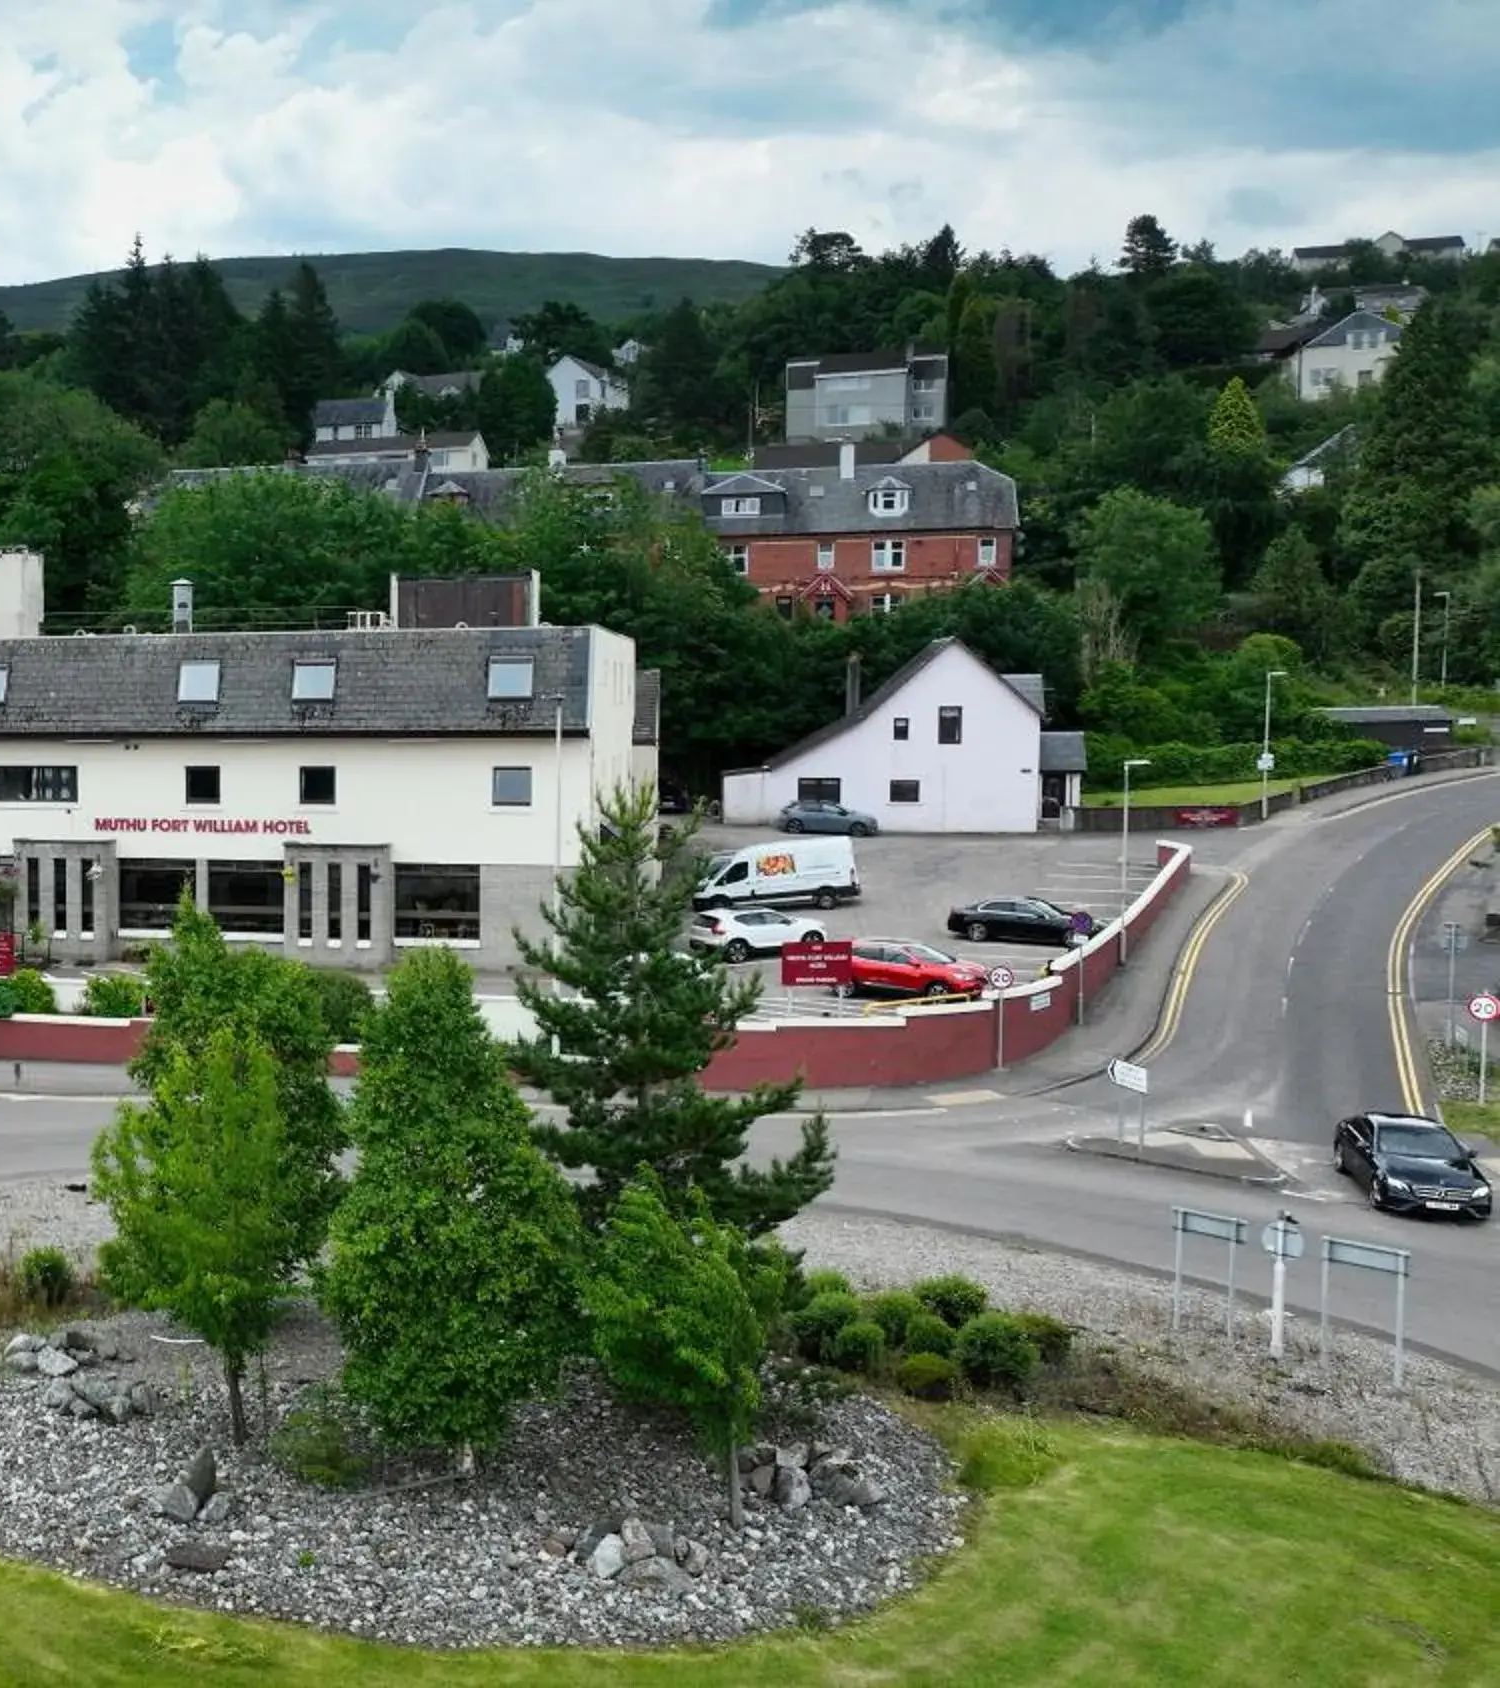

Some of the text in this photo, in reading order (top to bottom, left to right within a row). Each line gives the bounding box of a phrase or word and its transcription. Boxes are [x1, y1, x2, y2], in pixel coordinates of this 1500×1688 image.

[94, 817, 312, 835] MUTHU FORT WILLIAM HOTEL
[994, 972, 1009, 983] 20
[1473, 1002, 1495, 1015] 20
